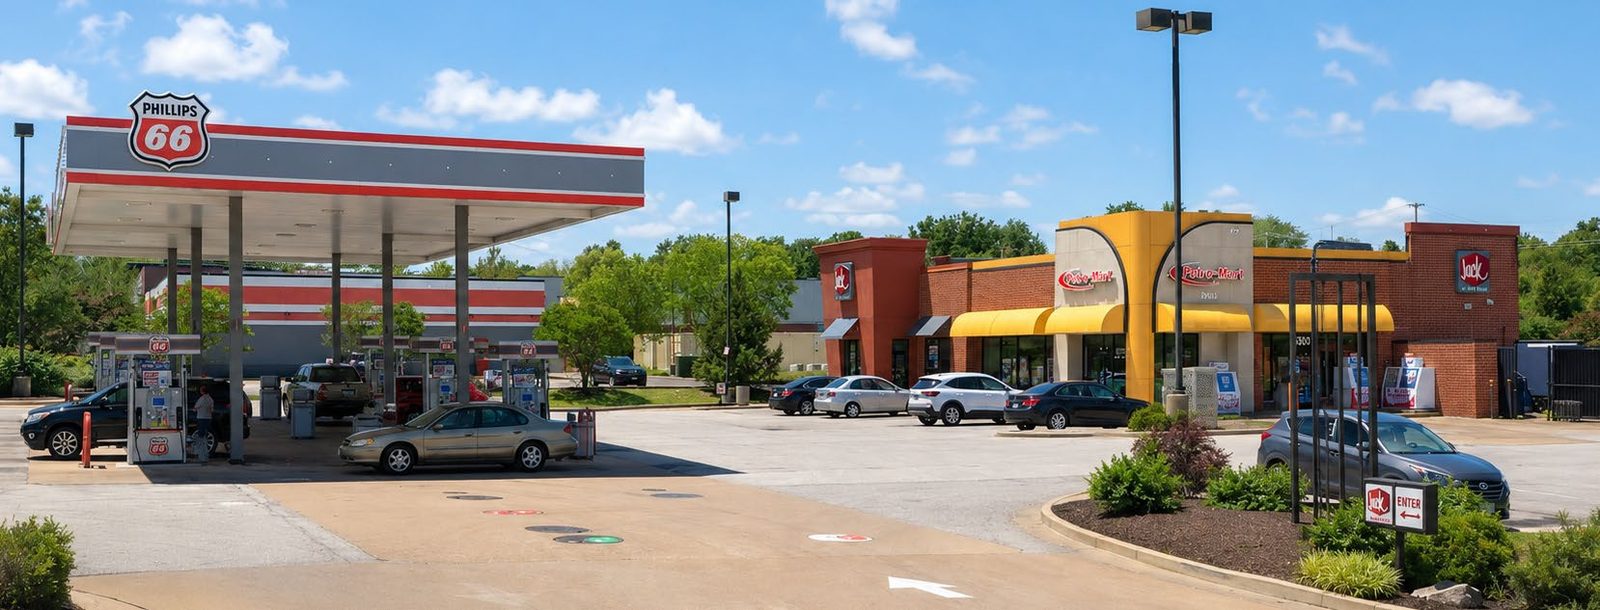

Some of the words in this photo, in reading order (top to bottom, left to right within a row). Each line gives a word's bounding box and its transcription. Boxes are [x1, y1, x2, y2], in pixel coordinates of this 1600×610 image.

[143, 102, 197, 117] PHILLIPS
[145, 124, 193, 152] 66
[1183, 266, 1245, 281] Petro-Mart
[1460, 256, 1488, 281] Jack
[1397, 496, 1421, 509] ENTER
